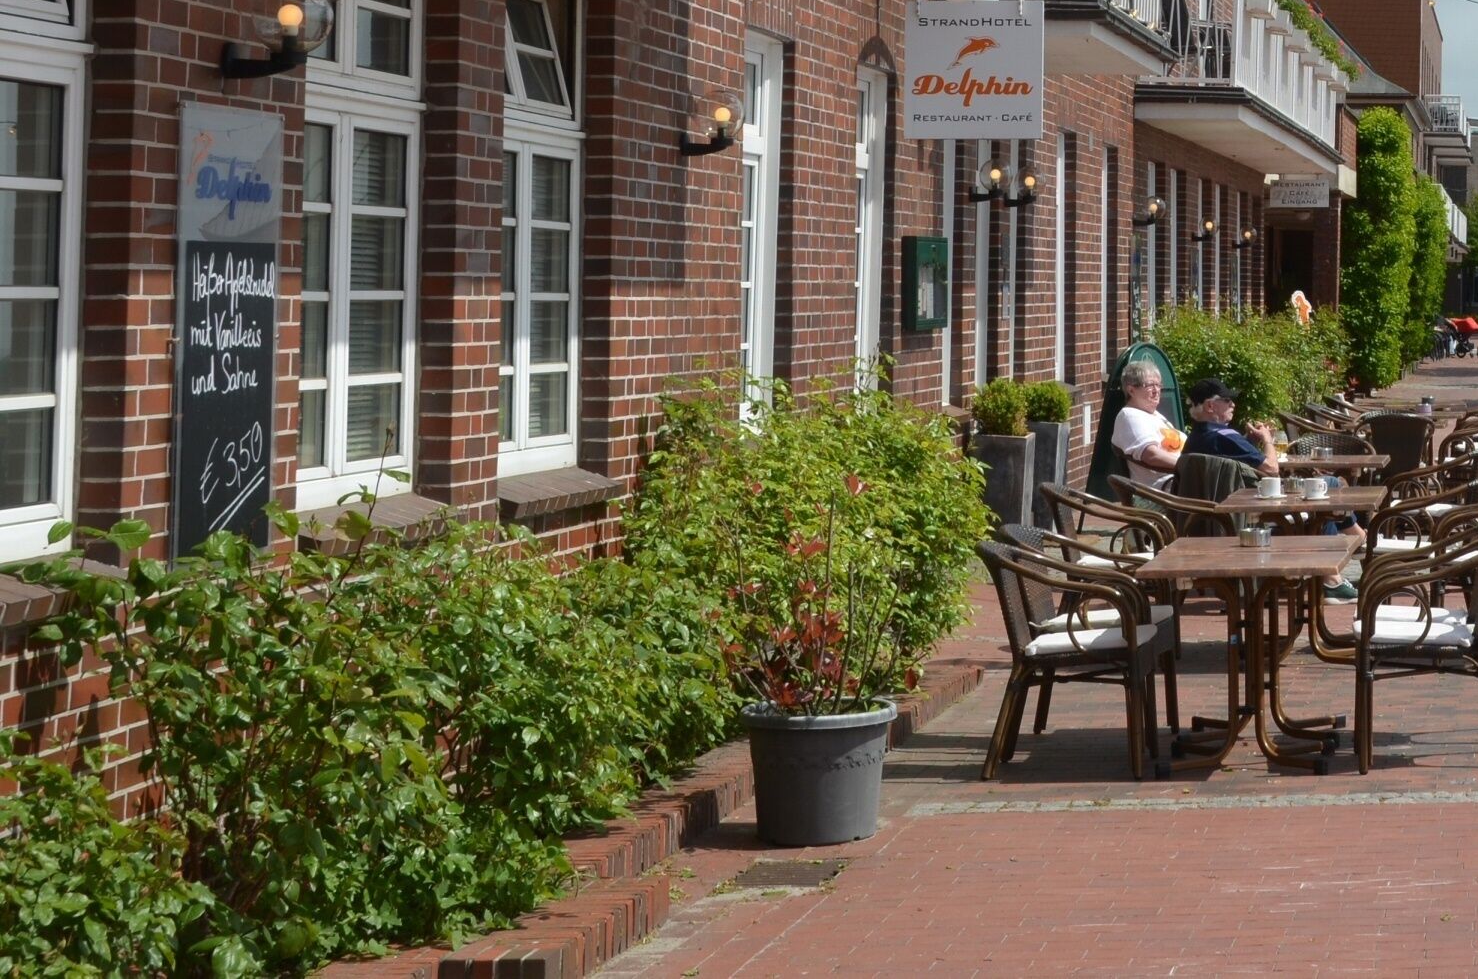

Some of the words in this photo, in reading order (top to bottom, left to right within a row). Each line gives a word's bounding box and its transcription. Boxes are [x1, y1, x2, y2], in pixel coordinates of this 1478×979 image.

[911, 67, 1034, 107] Delphin
[913, 114, 993, 122] RESTAURANT
[1001, 112, 1033, 122] CAFÉ
[195, 157, 272, 220] Delphin
[225, 251, 275, 317] Apfelstrudel
[190, 320, 213, 348] mit
[214, 310, 262, 351] Vanilleeis
[191, 354, 217, 395] und
[221, 352, 259, 395] Sahne
[222, 421, 263, 489] 3,50
